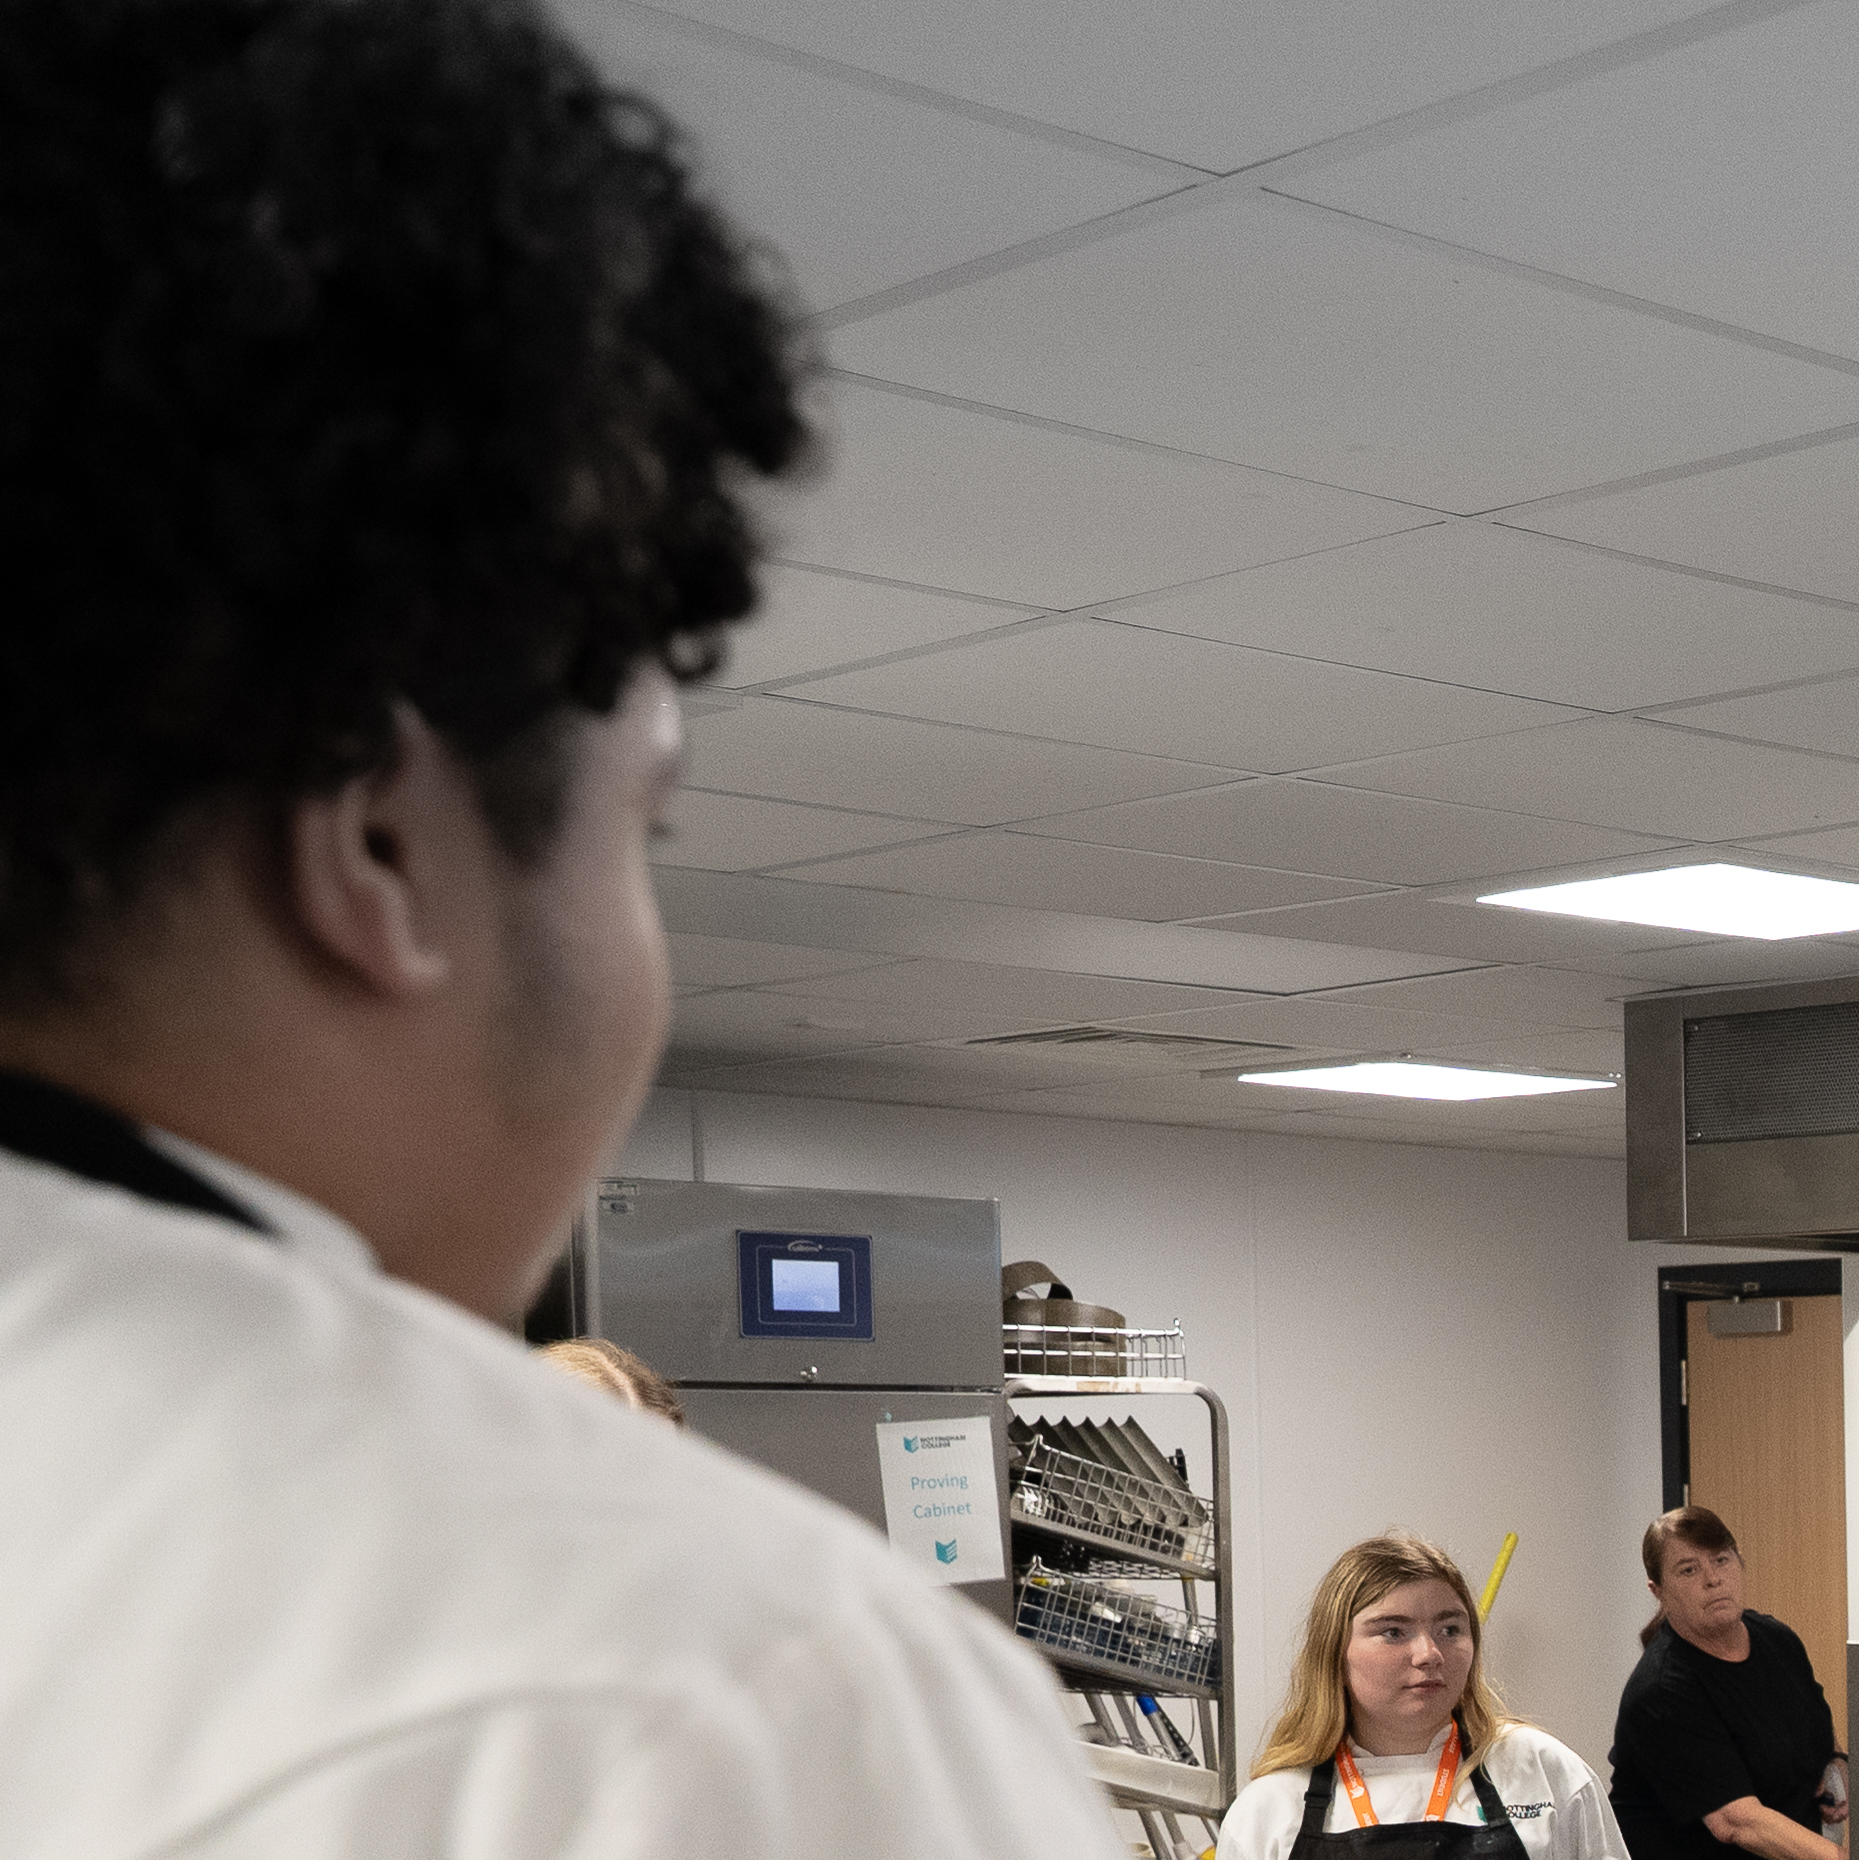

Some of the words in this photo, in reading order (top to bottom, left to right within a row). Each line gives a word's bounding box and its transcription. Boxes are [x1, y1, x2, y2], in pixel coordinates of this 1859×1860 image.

[910, 1473, 969, 1491] Proving
[912, 1502, 972, 1519] Cabinet
[1504, 1801, 1554, 1813] OTTINGHA
[1507, 1811, 1541, 1820] OLLEGE
